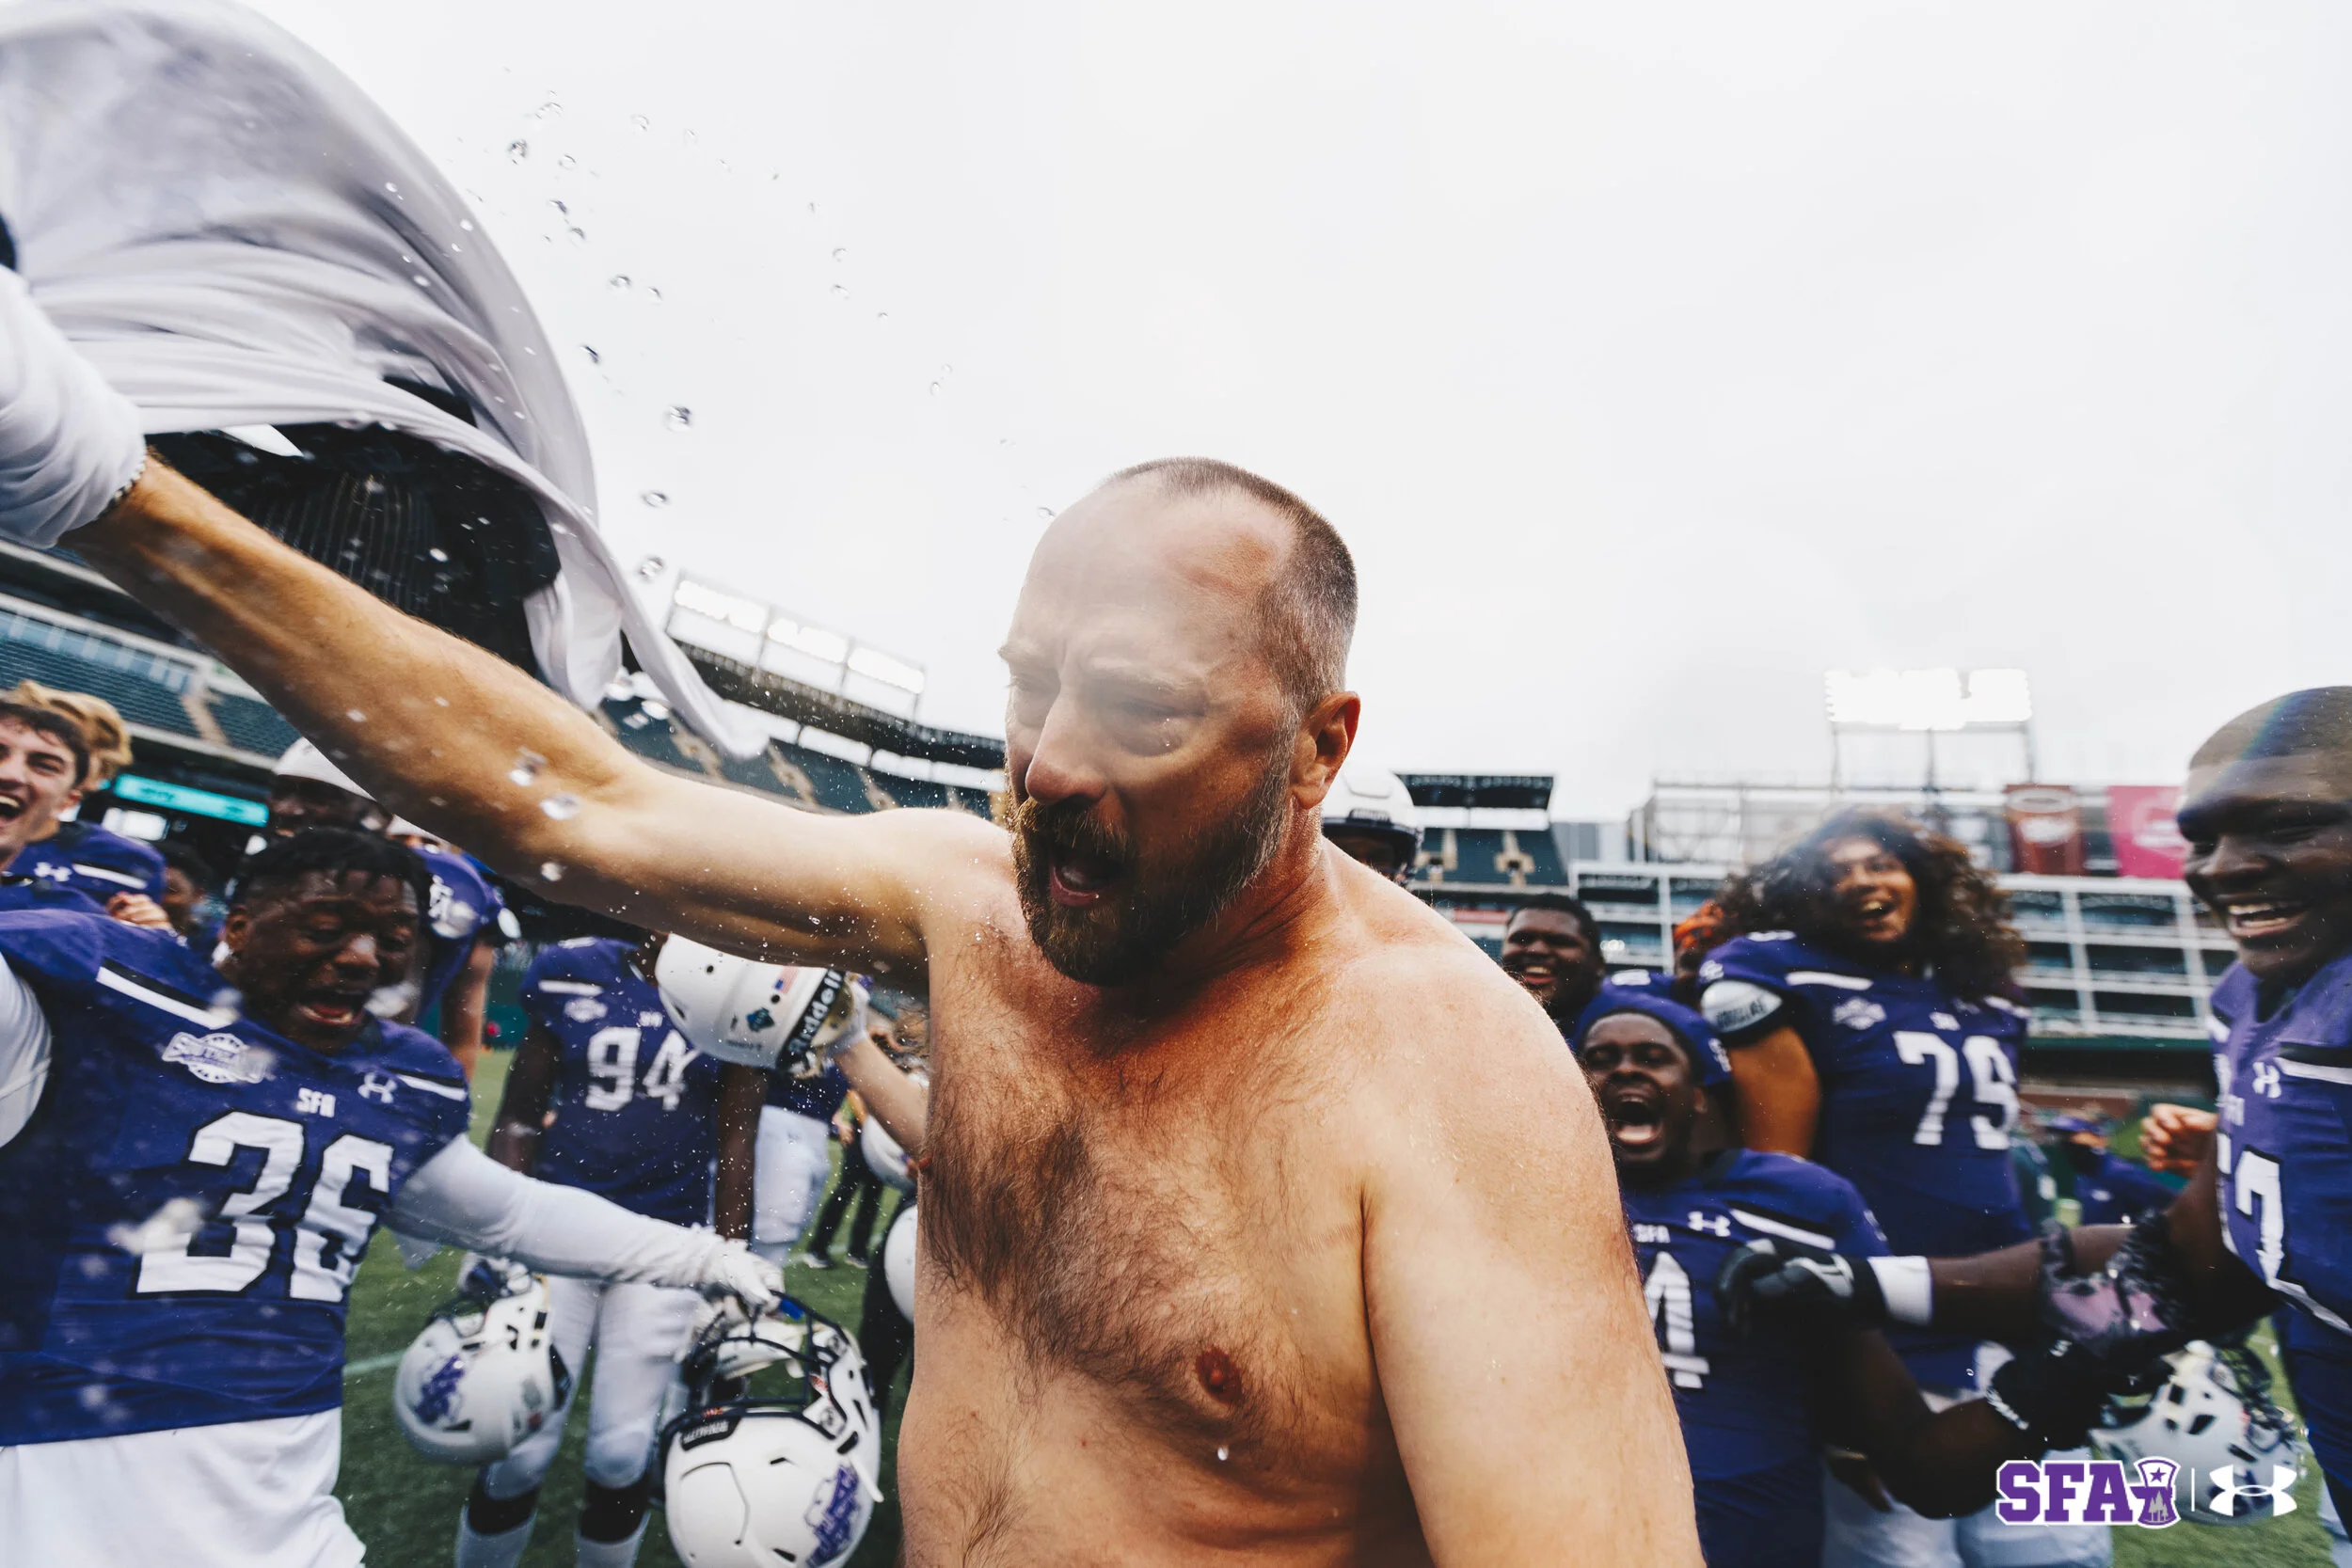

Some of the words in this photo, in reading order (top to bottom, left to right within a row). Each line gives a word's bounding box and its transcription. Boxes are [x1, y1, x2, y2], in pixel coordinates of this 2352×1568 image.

[296, 1086, 337, 1117] SFA
[584, 1025, 696, 1112] 94
[1892, 1030, 2020, 1149] 79
[136, 1111, 393, 1302] 36
